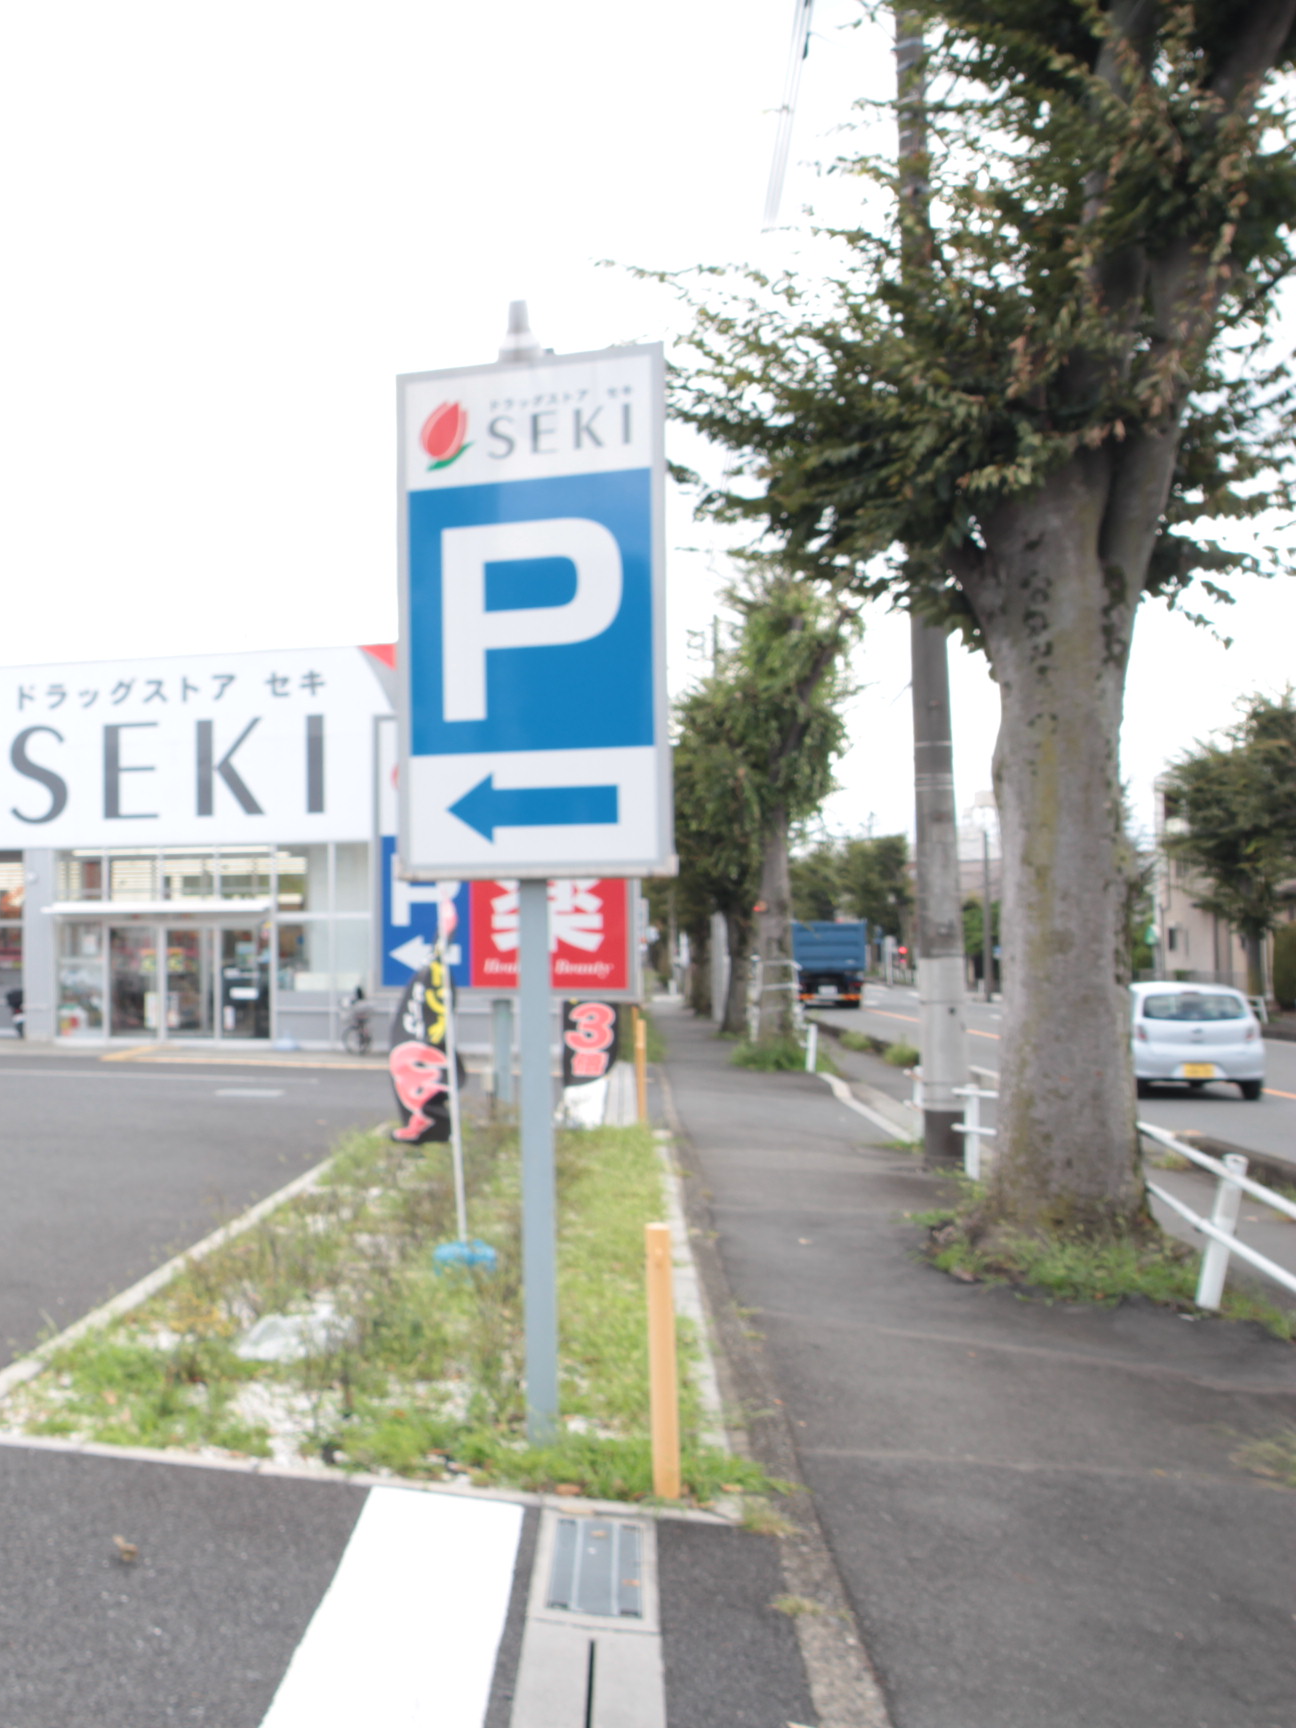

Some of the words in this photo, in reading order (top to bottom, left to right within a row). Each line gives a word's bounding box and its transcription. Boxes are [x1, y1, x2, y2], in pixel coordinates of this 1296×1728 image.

[487, 402, 633, 461] SEKI
[441, 516, 624, 723] P
[16, 673, 237, 711] ドラッグストア
[264, 669, 327, 698] セキ
[9, 713, 326, 825] SEKI
